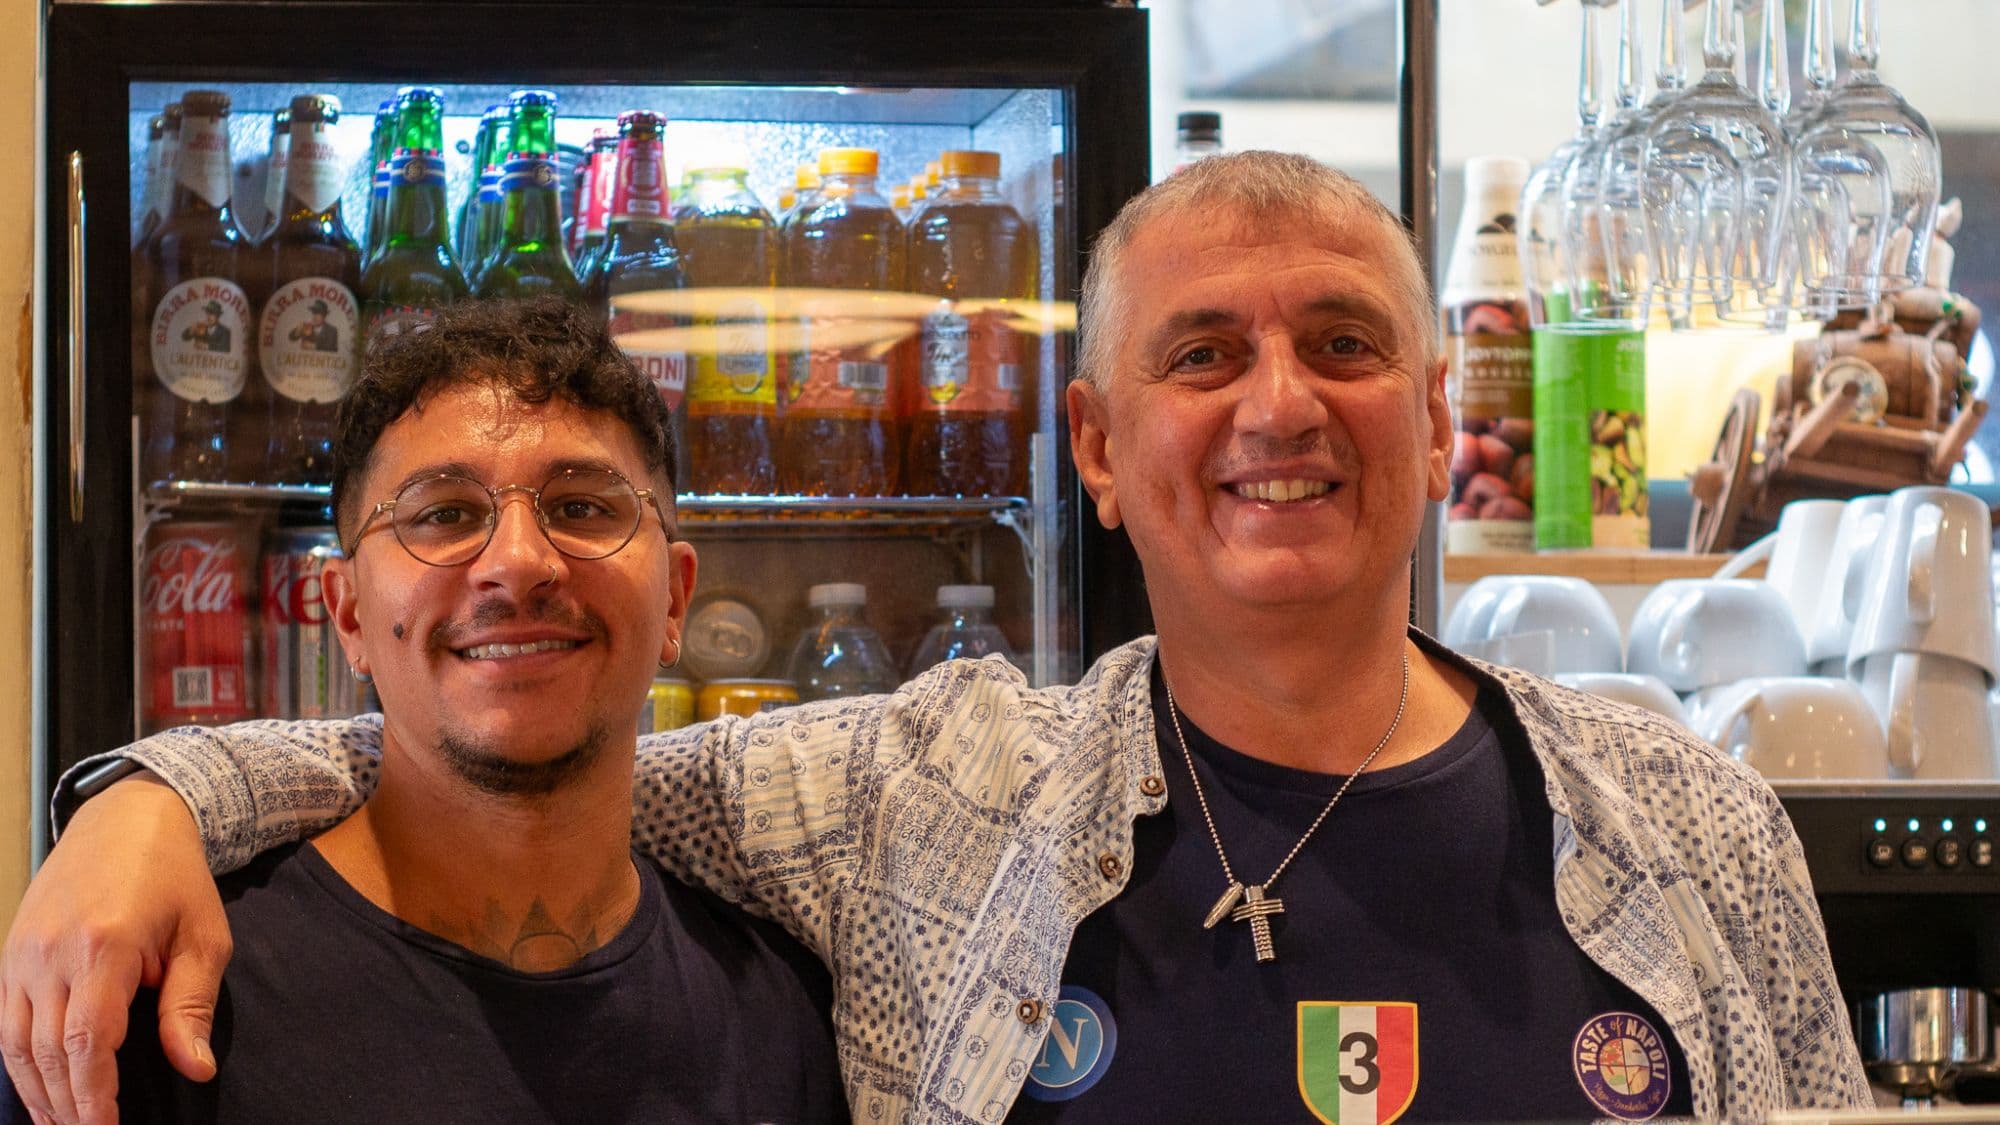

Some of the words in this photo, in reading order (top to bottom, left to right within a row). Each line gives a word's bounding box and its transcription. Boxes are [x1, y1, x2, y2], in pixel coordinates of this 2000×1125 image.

[155, 285, 199, 346] BIRRA
[263, 286, 304, 347] BIRRA
[1036, 1018, 1089, 1070] N
[1338, 1032, 1381, 1095] 3
[1580, 1022, 1610, 1074] TASTE
[1625, 1018, 1665, 1080] NAPOLI
